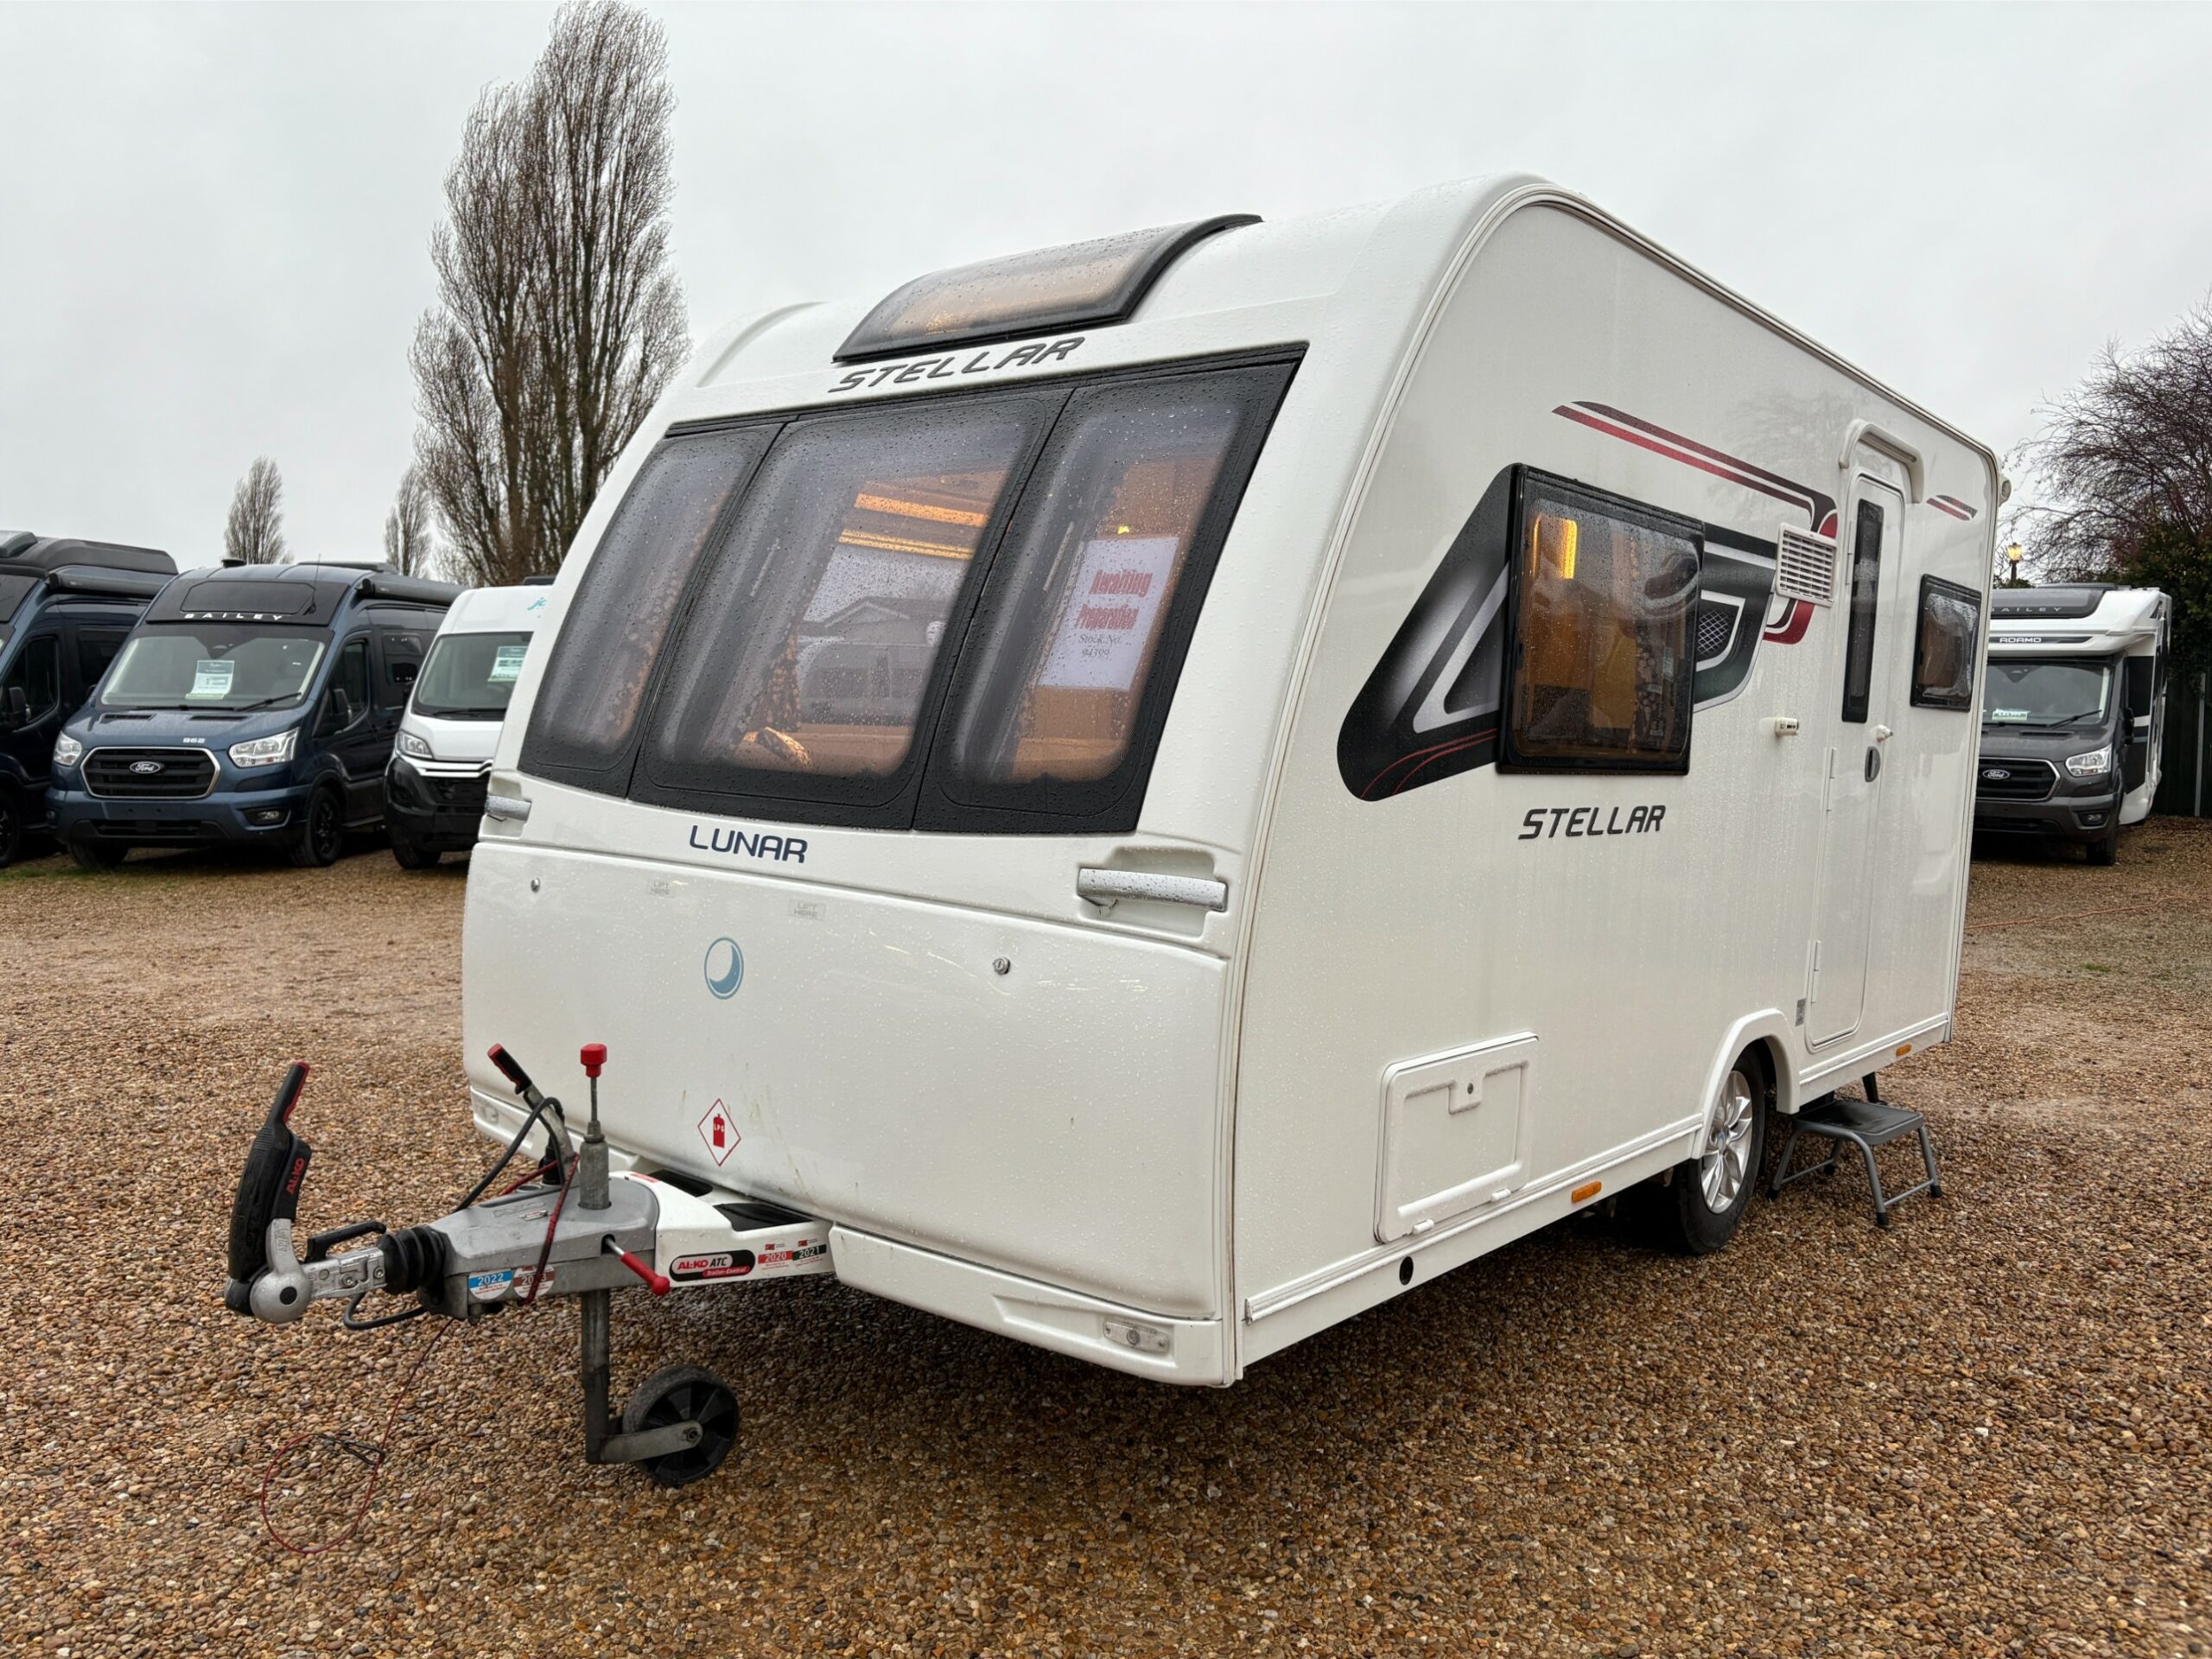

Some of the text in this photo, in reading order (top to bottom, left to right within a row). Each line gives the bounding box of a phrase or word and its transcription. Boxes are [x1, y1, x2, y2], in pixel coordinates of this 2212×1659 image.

[828, 336, 1085, 393] STELLAR
[1088, 569, 1154, 598] Awaiting
[1074, 602, 1140, 631] Preparation
[1078, 633, 1103, 644] Stock
[1517, 804, 1666, 840] STELLAR
[690, 824, 808, 863] LUNAR
[765, 1252, 787, 1262] 2020
[798, 1246, 820, 1259] 2021
[709, 1257, 728, 1268] ATC
[477, 1273, 504, 1287] 2022
[521, 1274, 547, 1286] 203
